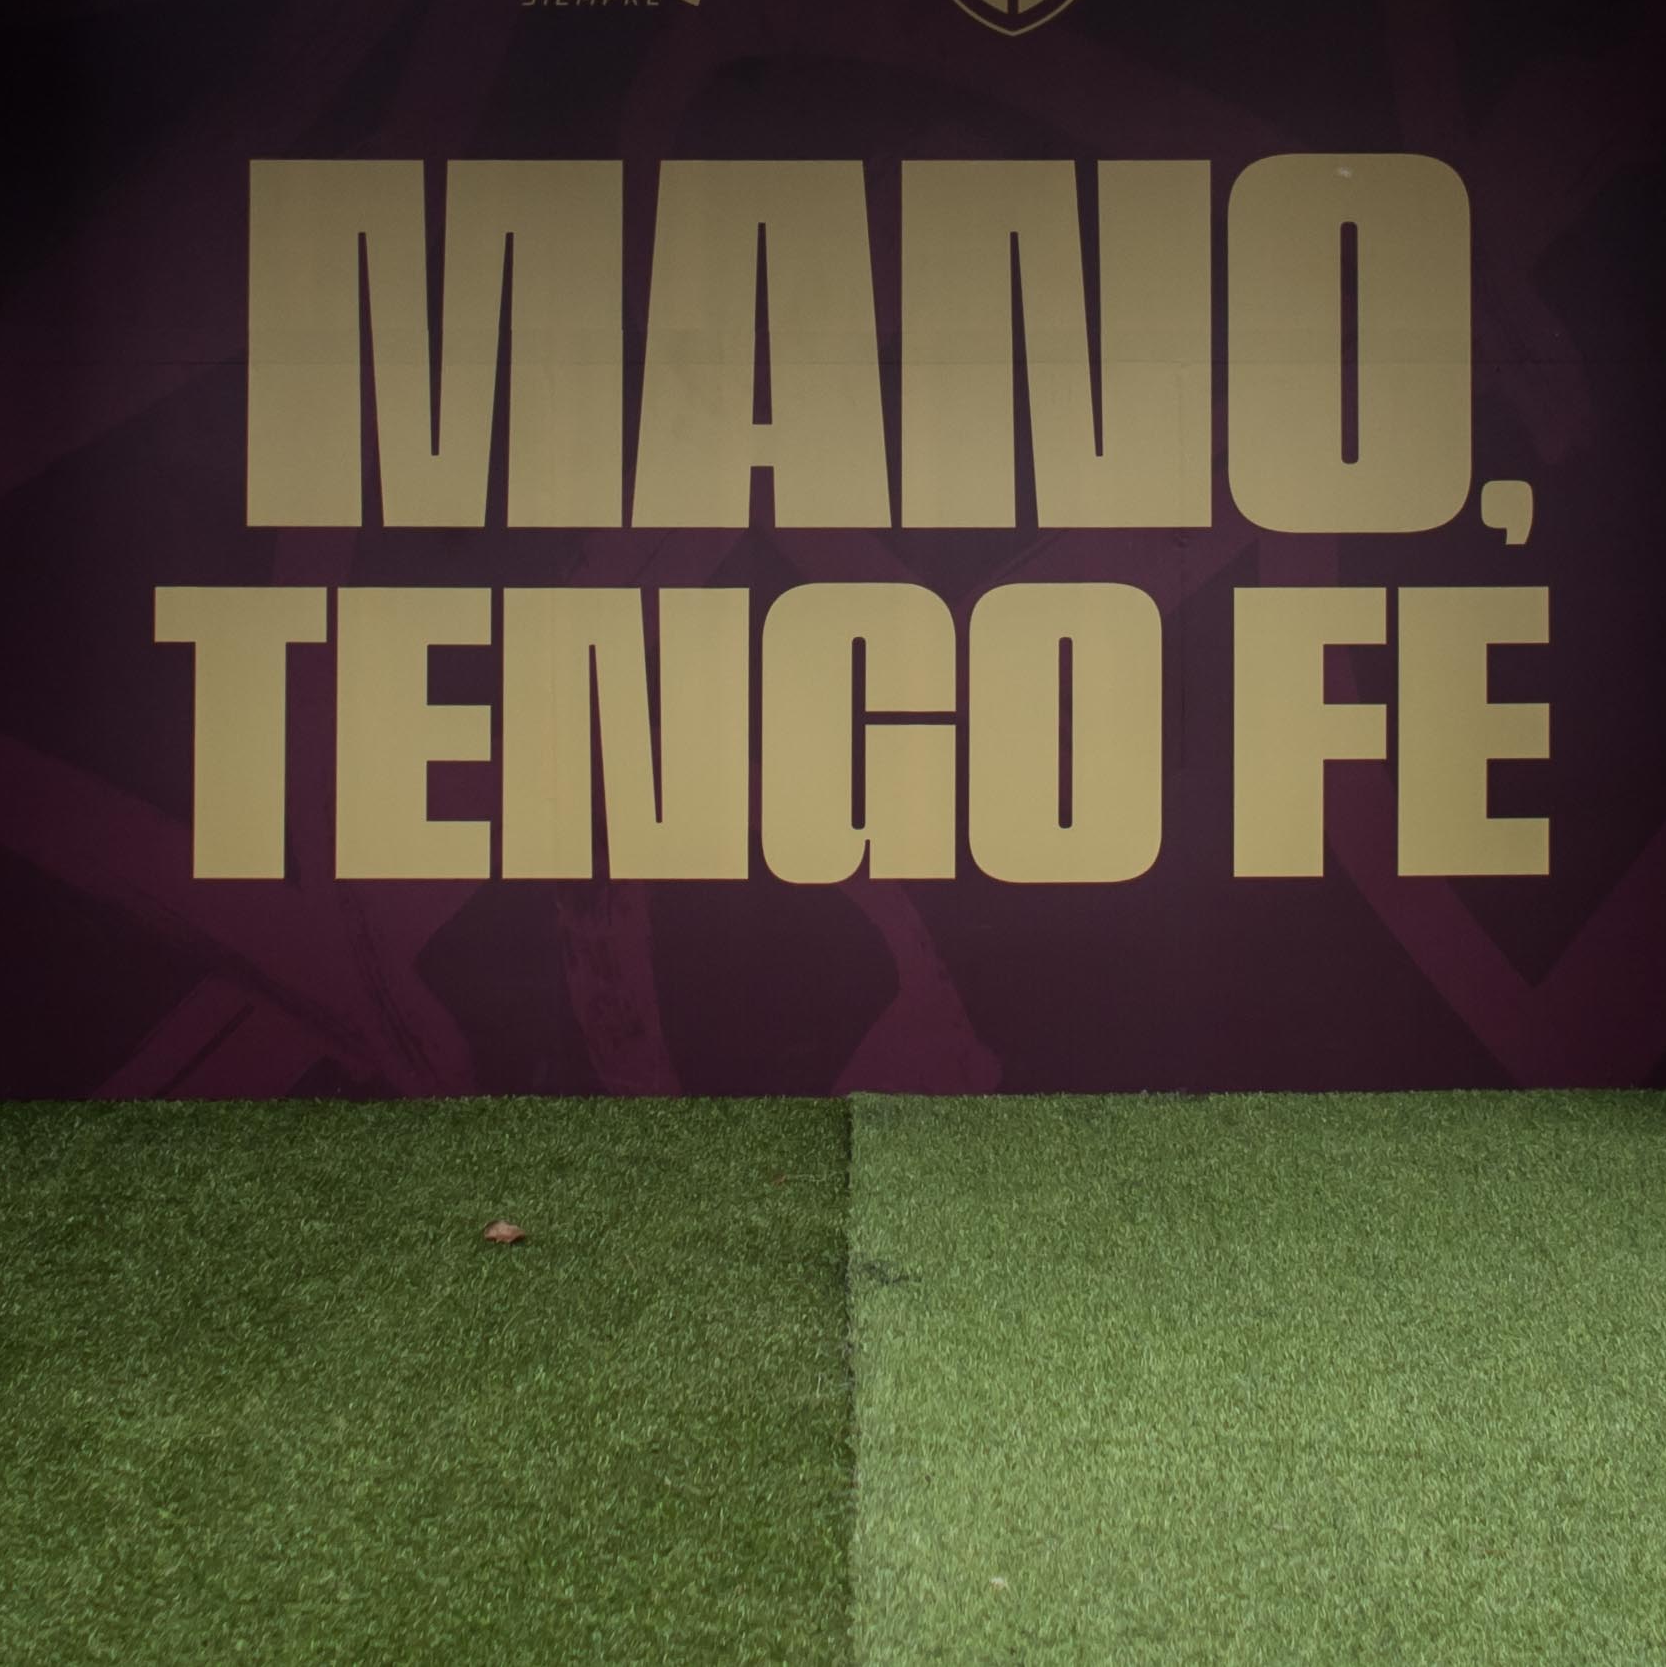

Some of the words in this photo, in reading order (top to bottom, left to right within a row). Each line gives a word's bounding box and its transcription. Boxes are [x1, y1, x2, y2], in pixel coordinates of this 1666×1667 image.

[245, 152, 1536, 547] MANO,
[152, 581, 1164, 885] TENGO
[1231, 585, 1551, 880] FE
